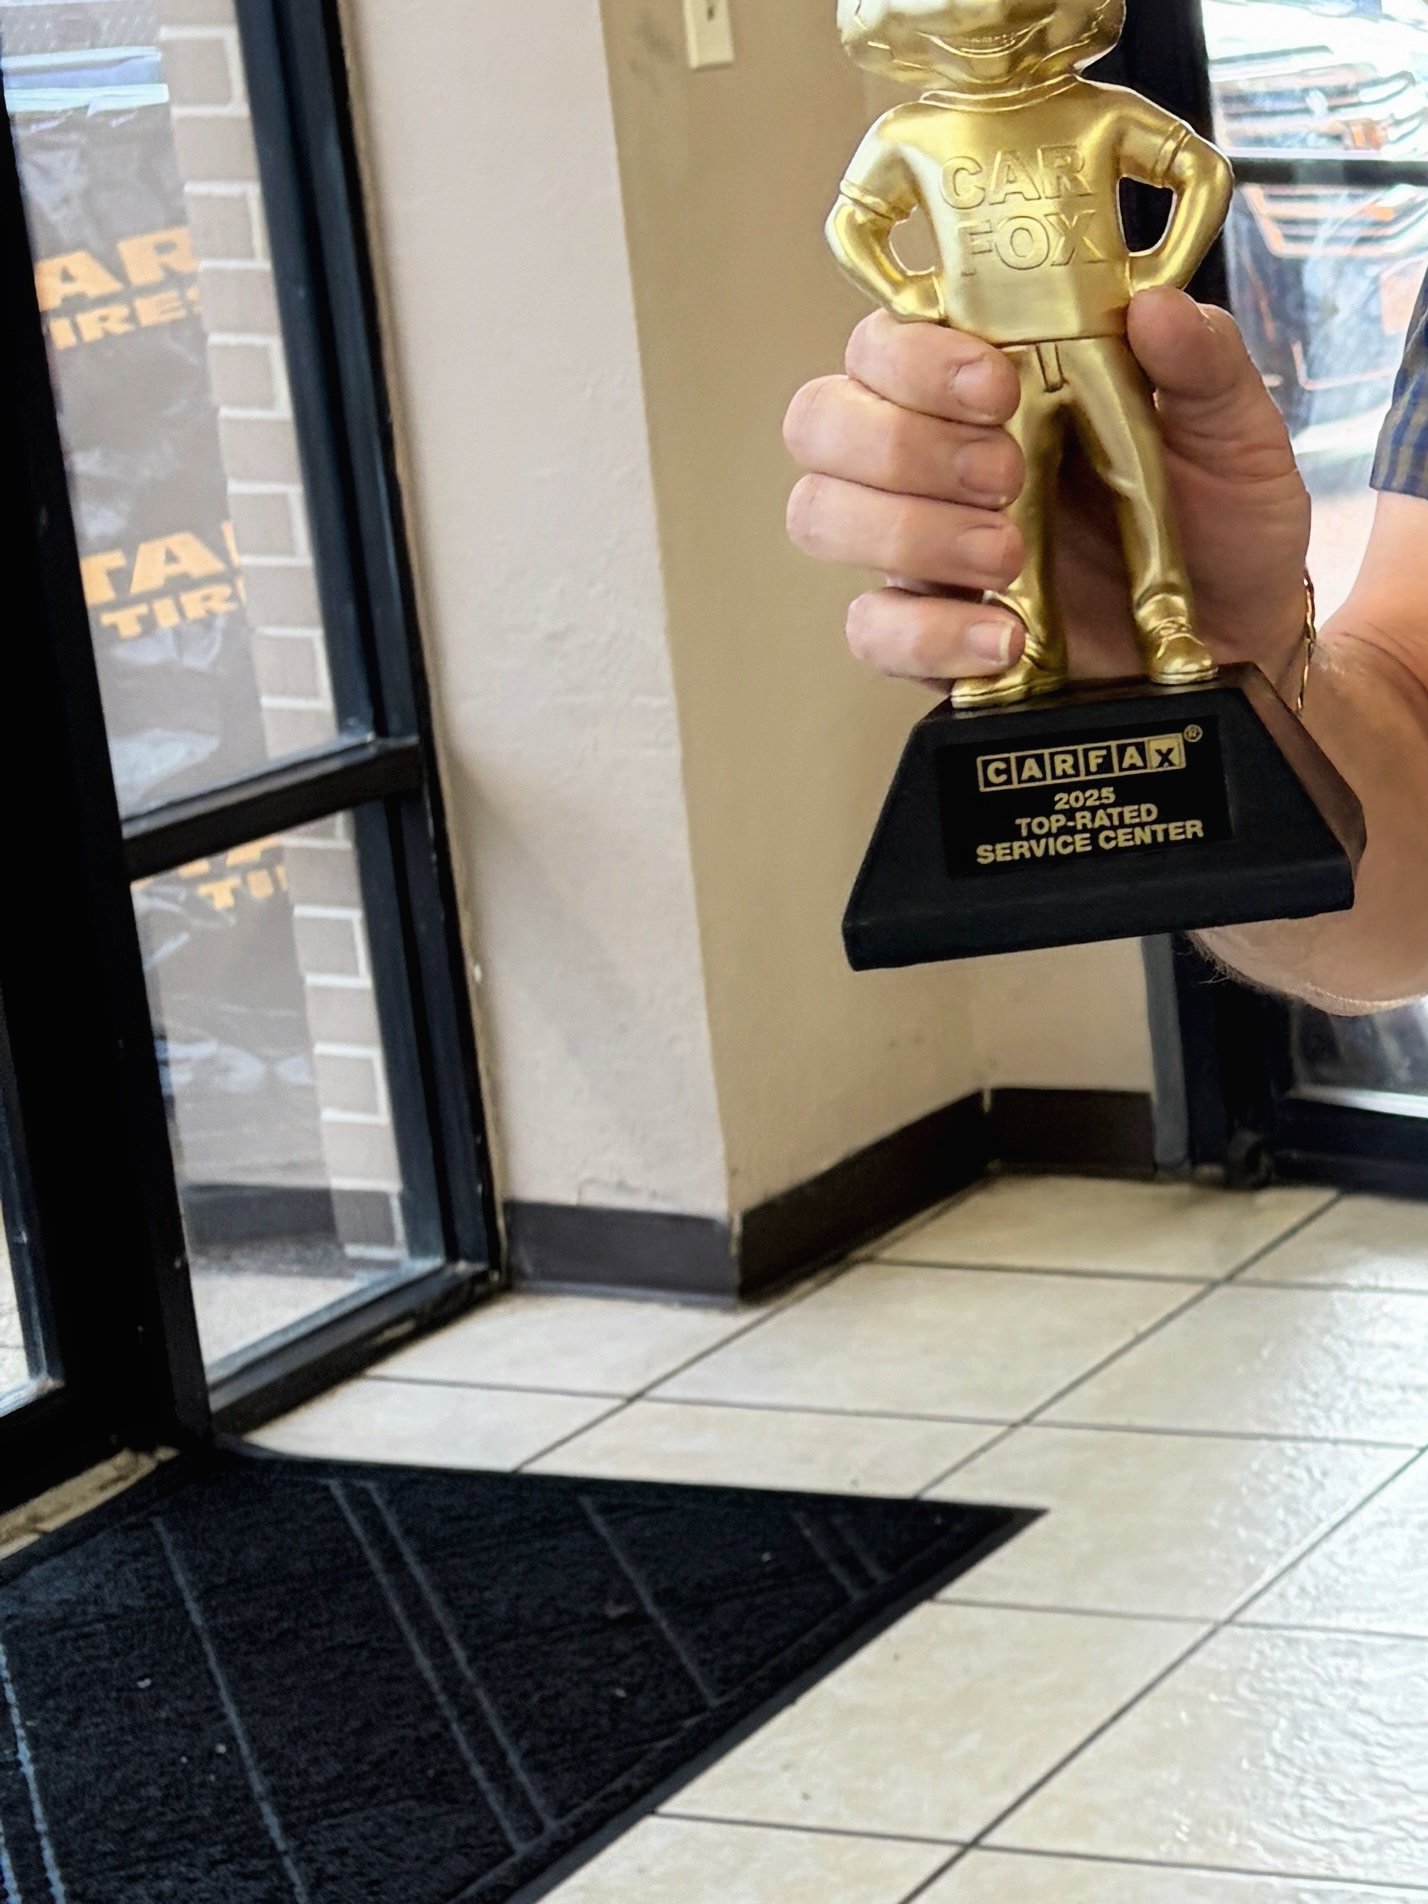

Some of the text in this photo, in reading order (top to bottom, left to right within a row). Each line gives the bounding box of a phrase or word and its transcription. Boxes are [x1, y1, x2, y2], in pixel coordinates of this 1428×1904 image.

[941, 143, 1094, 210] CAR
[34, 224, 199, 313] AR
[956, 208, 1107, 278] FOX
[47, 288, 200, 352] IRE
[101, 576, 247, 639] TIR
[1015, 802, 1159, 836] TOP-RATED
[1053, 786, 1117, 810] 2025
[976, 819, 1205, 865] SERVICE CENTER
